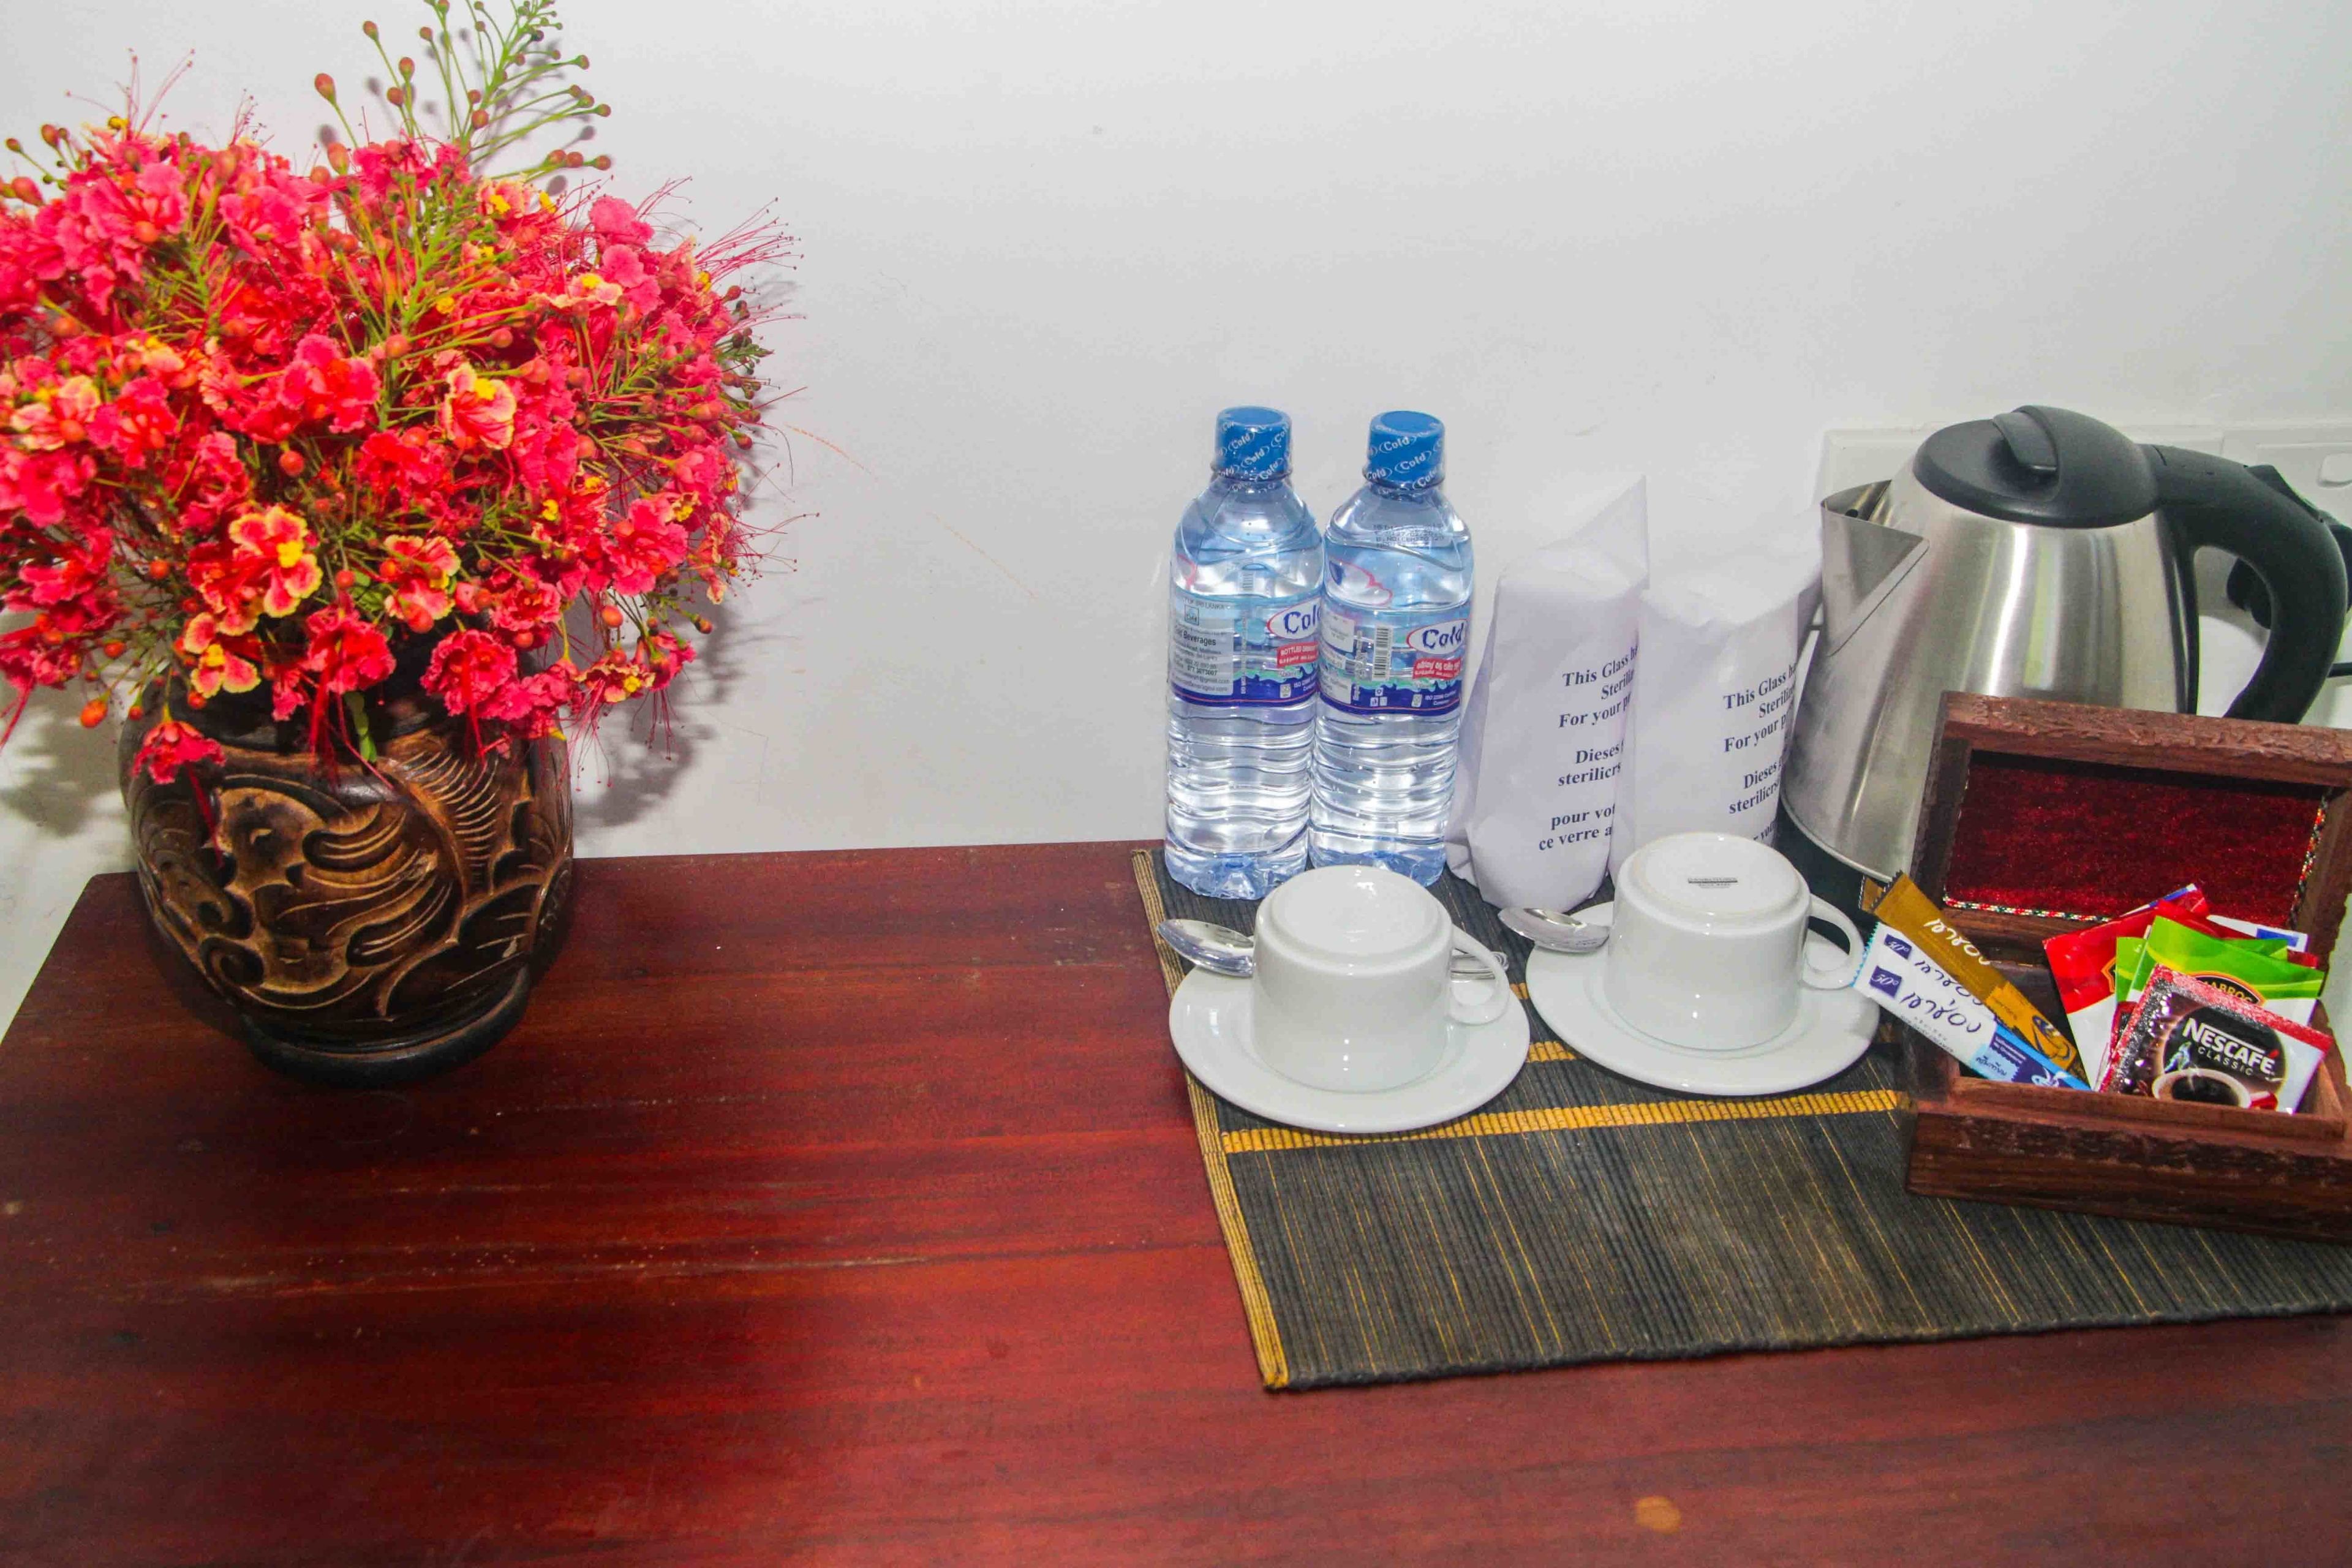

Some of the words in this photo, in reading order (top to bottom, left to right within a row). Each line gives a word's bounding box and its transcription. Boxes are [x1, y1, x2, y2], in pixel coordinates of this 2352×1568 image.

[1231, 432, 1250, 450] Cold
[1384, 435, 1409, 451] Cold
[1244, 448, 1265, 466] Cold
[1400, 453, 1427, 470] Cold
[1259, 461, 1278, 480] Cold
[1183, 630, 1217, 647] Beverages
[1422, 622, 1464, 649] Cold
[1562, 669, 1597, 687] This
[1602, 654, 1629, 678] Glass
[1722, 689, 1755, 710] This
[1758, 672, 1786, 696] Glass
[1558, 713, 1588, 729] For
[1591, 701, 1621, 726] your
[1724, 735, 1751, 753] For
[1754, 720, 1779, 747] your
[1575, 744, 1619, 764] Dieses
[1743, 761, 1777, 790] Dieses
[1550, 810, 1590, 831] pour
[1539, 838, 1554, 851] ce
[1559, 828, 1600, 845] verre
[2182, 1017, 2280, 1075] NESCAFÉ
[2198, 1046, 2254, 1076] CLASSIC
